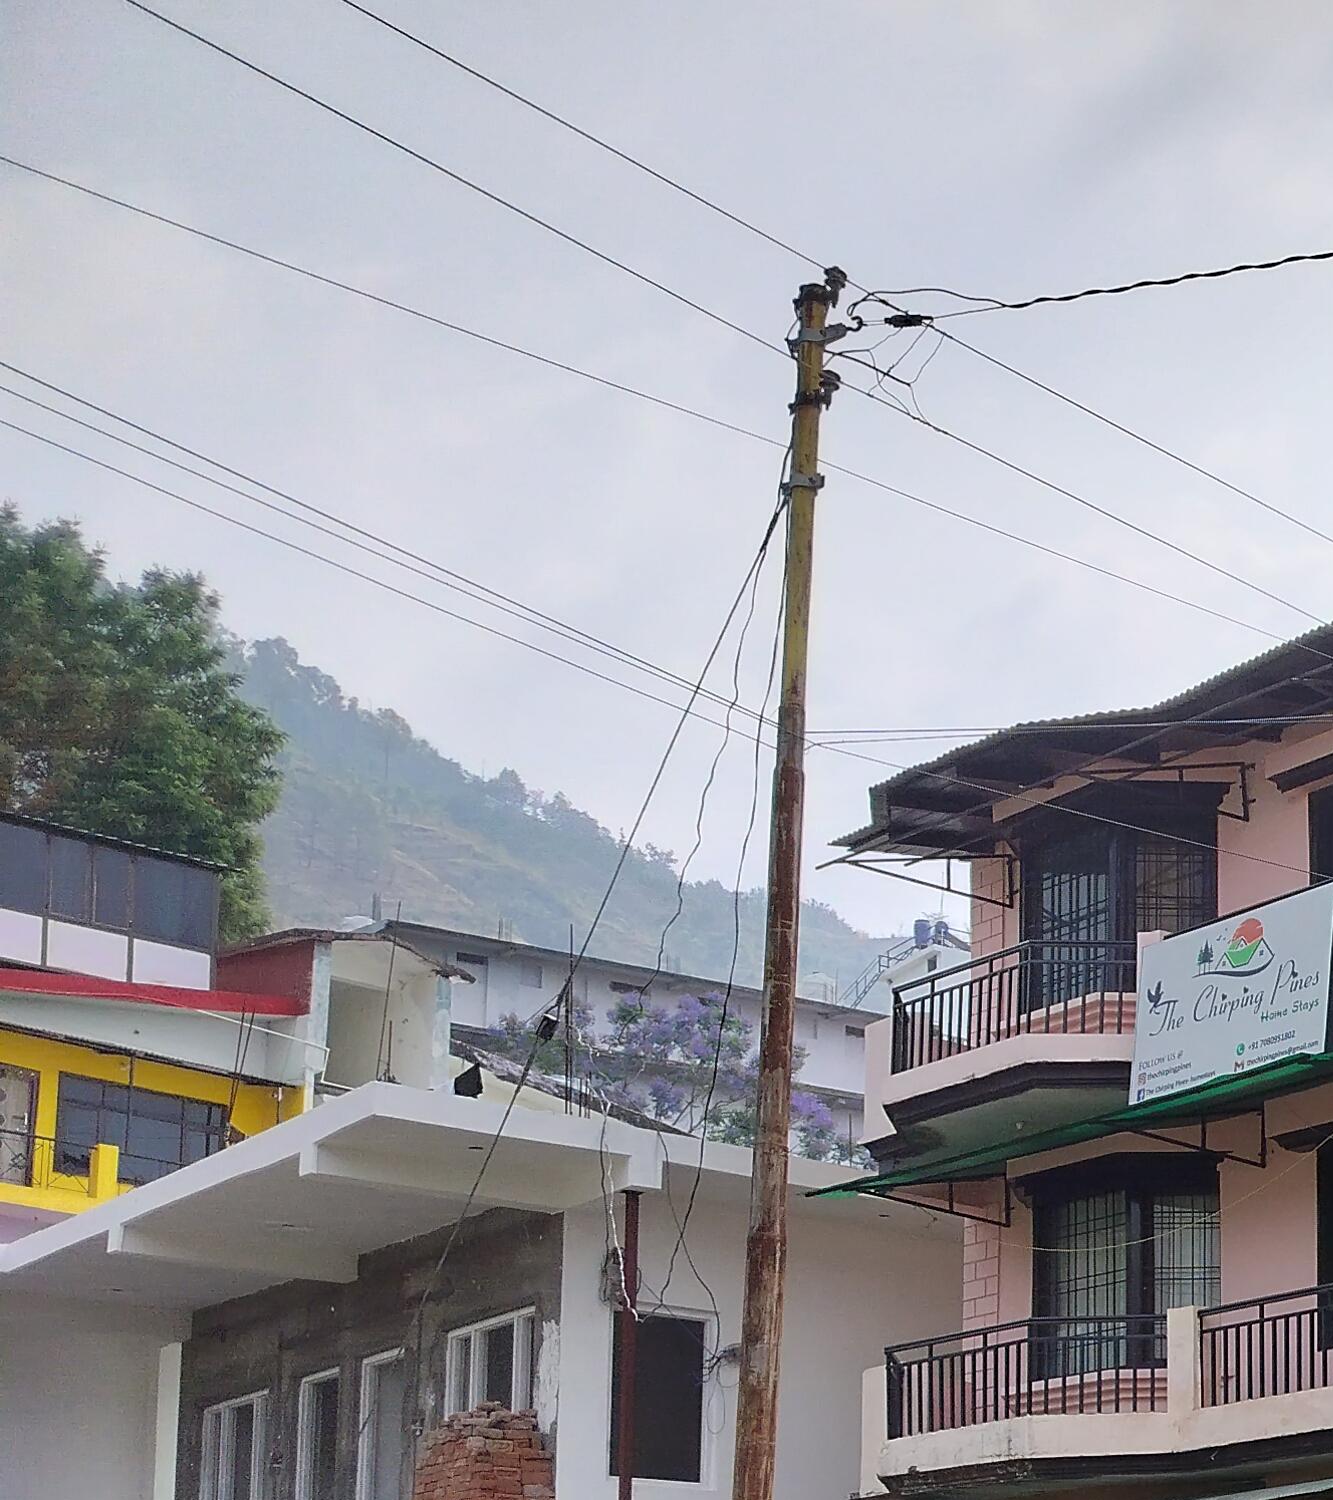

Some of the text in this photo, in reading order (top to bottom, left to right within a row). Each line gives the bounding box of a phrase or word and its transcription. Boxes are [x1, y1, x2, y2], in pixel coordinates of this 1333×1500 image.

[1149, 959, 1320, 1036] The Chirping Pines
[1260, 998, 1320, 1023] Home Stays
[1247, 1040, 1258, 1050] +91
[1138, 1056, 1165, 1071] FOLLOW
[1167, 1053, 1176, 1062] US
